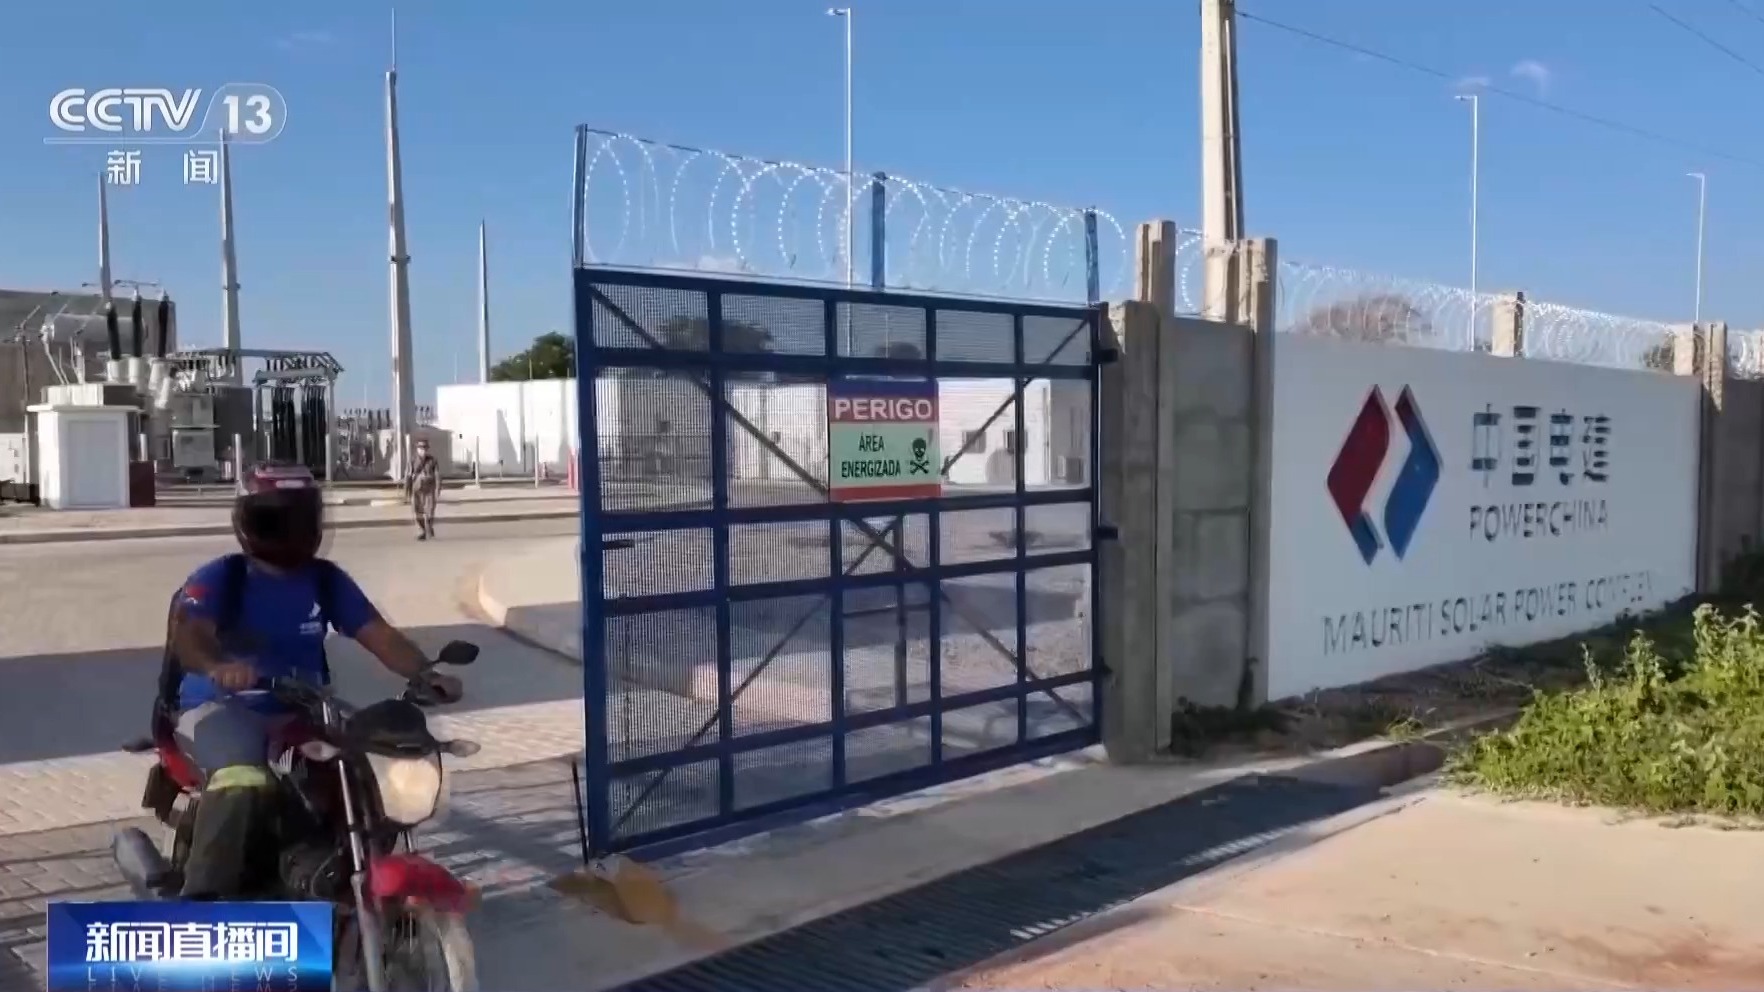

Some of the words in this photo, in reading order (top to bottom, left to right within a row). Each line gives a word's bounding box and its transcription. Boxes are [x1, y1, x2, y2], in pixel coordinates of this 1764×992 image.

[834, 398, 933, 420] PERIGO
[858, 432, 885, 453] ÁREA
[1471, 403, 1611, 489] 中国电建
[841, 459, 902, 478] ENERGIZADA
[1469, 499, 1608, 543] POWERCHINA
[1322, 602, 1433, 656] MAURITI
[1441, 590, 1507, 637] SOLAR
[1513, 581, 1577, 623] POWER
